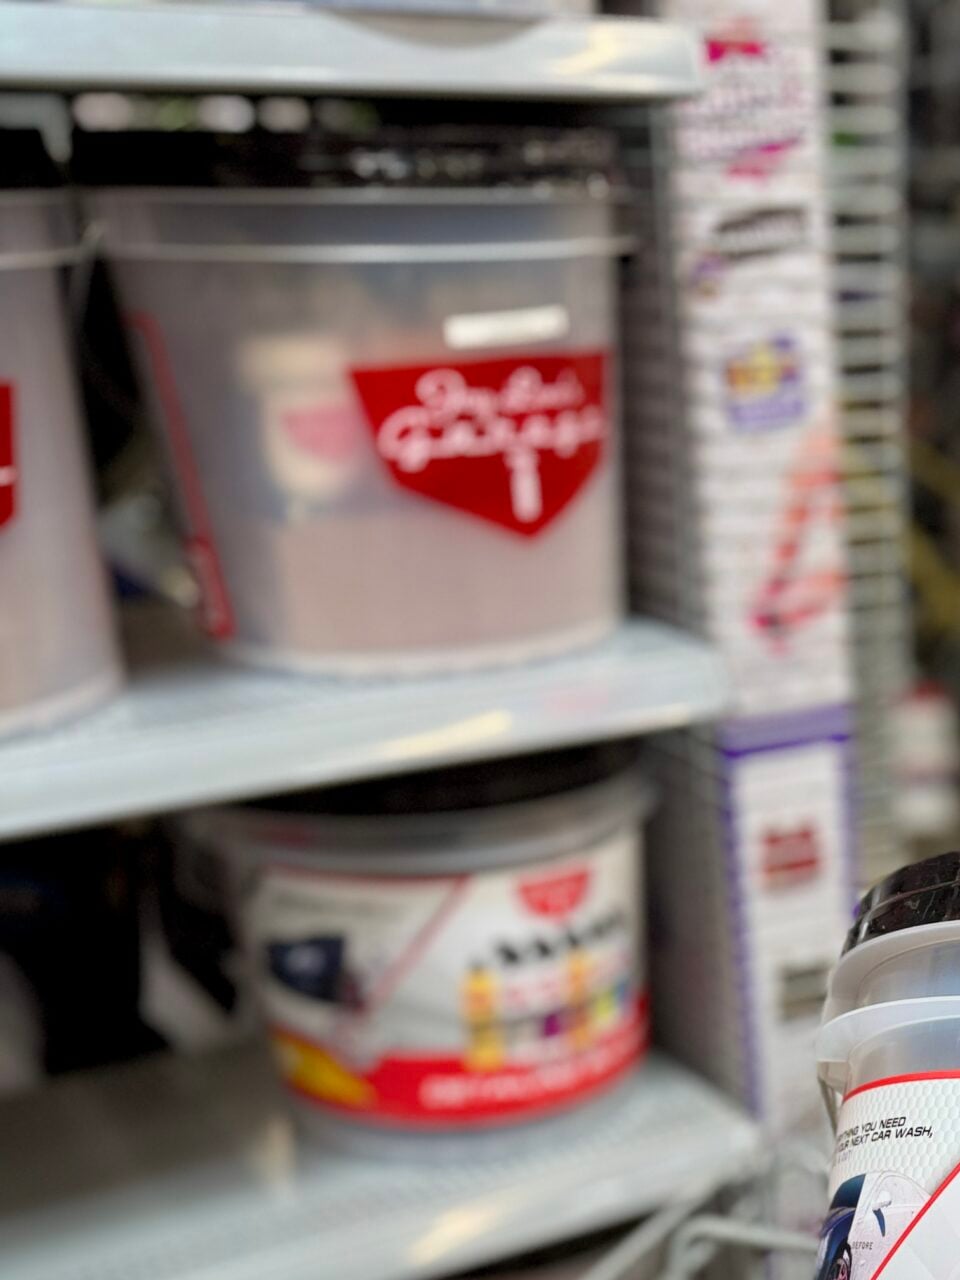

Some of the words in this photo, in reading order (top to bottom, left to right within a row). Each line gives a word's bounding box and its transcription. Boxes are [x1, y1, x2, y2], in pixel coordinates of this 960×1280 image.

[861, 1120, 877, 1133] YOU
[879, 1116, 907, 1129] NEED
[851, 1134, 871, 1147] NEXT
[871, 1129, 891, 1142] CAR
[895, 1125, 934, 1139] WASH,
